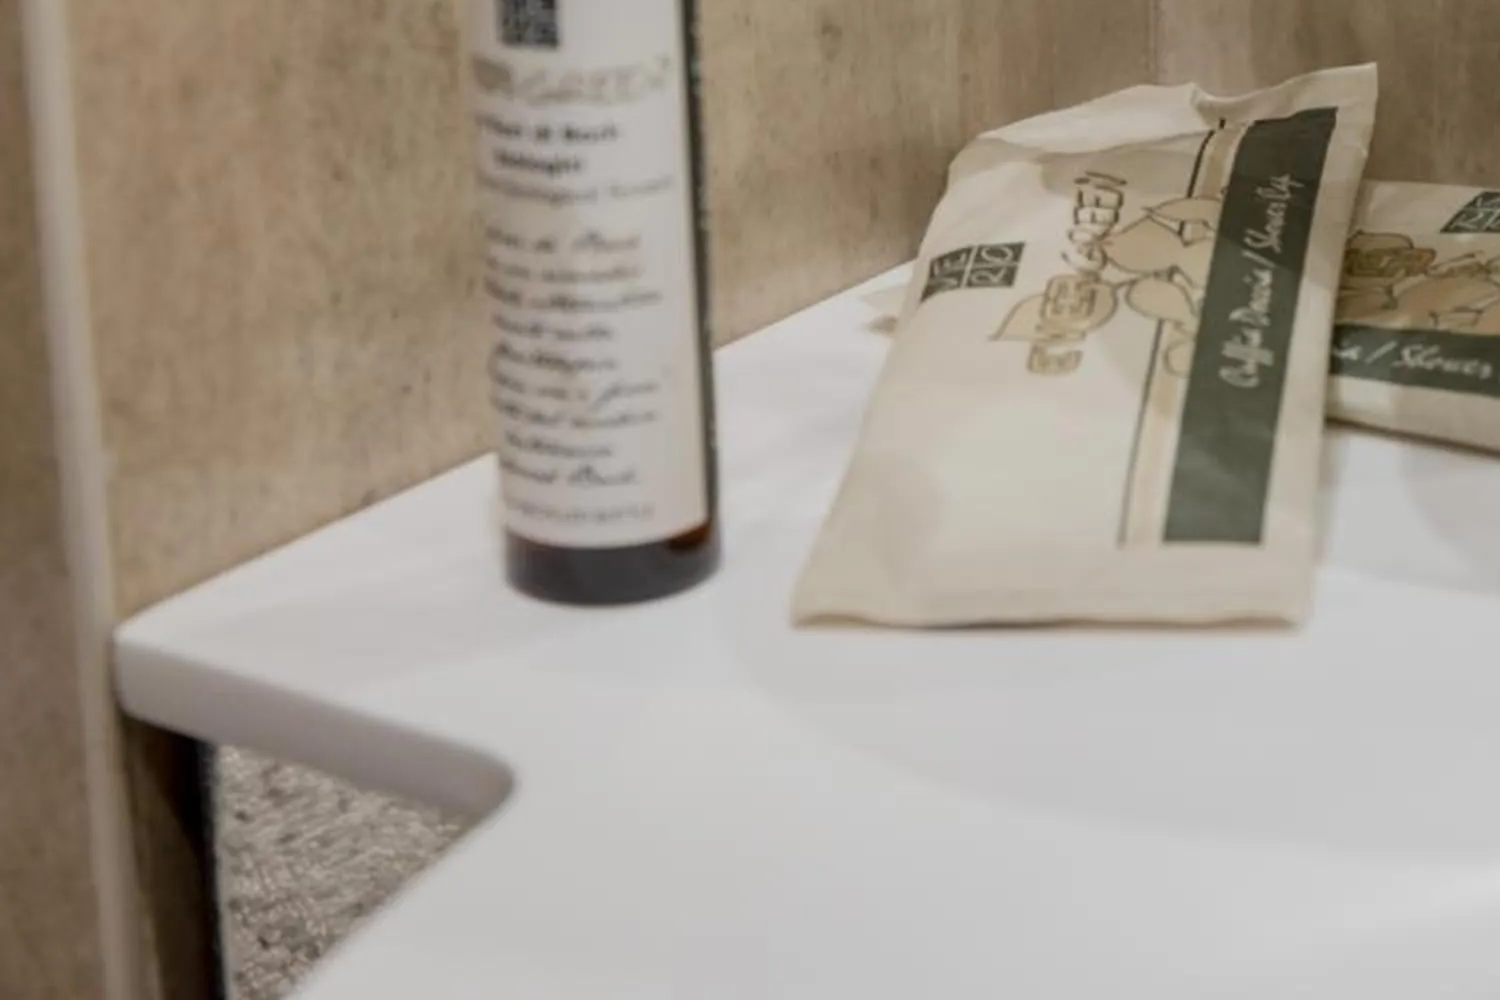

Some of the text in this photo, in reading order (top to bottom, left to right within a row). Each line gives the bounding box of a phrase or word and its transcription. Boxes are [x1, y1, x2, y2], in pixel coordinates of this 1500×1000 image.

[1255, 173, 1305, 200] Cap
[1243, 201, 1287, 253] Shower
[1393, 343, 1493, 379] Shower
